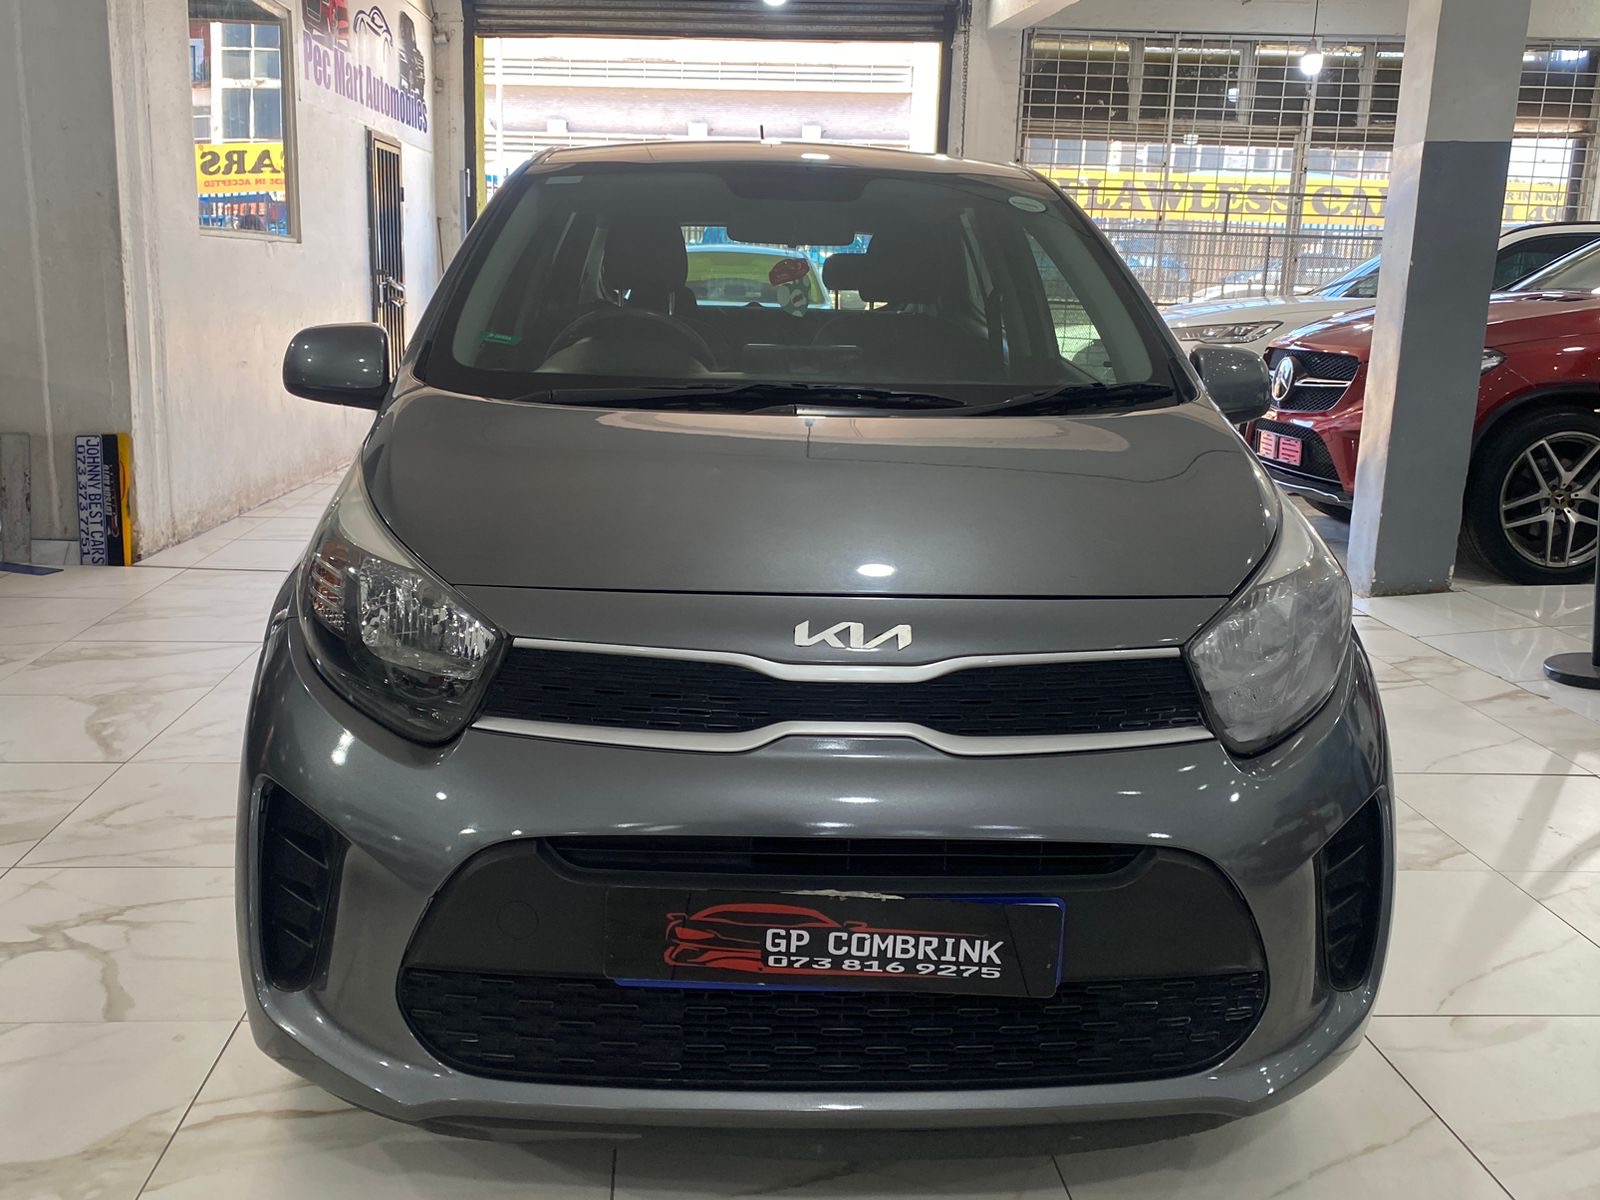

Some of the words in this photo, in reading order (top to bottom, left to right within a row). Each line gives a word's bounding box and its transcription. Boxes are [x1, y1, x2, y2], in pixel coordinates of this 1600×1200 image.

[303, 29, 331, 90] Pec
[334, 47, 364, 105] Mart
[366, 65, 427, 133] Automobiles
[77, 444, 86, 475] 073
[86, 439, 101, 489] JOHNNY
[79, 481, 88, 511] 373
[88, 493, 103, 527] BEST
[90, 530, 105, 564] CARS
[794, 620, 912, 650] KIA
[765, 928, 810, 953] GP
[828, 931, 1004, 965] COMBRINK
[768, 955, 832, 969] 073
[842, 959, 905, 973] 816
[916, 963, 1001, 979] 9275
